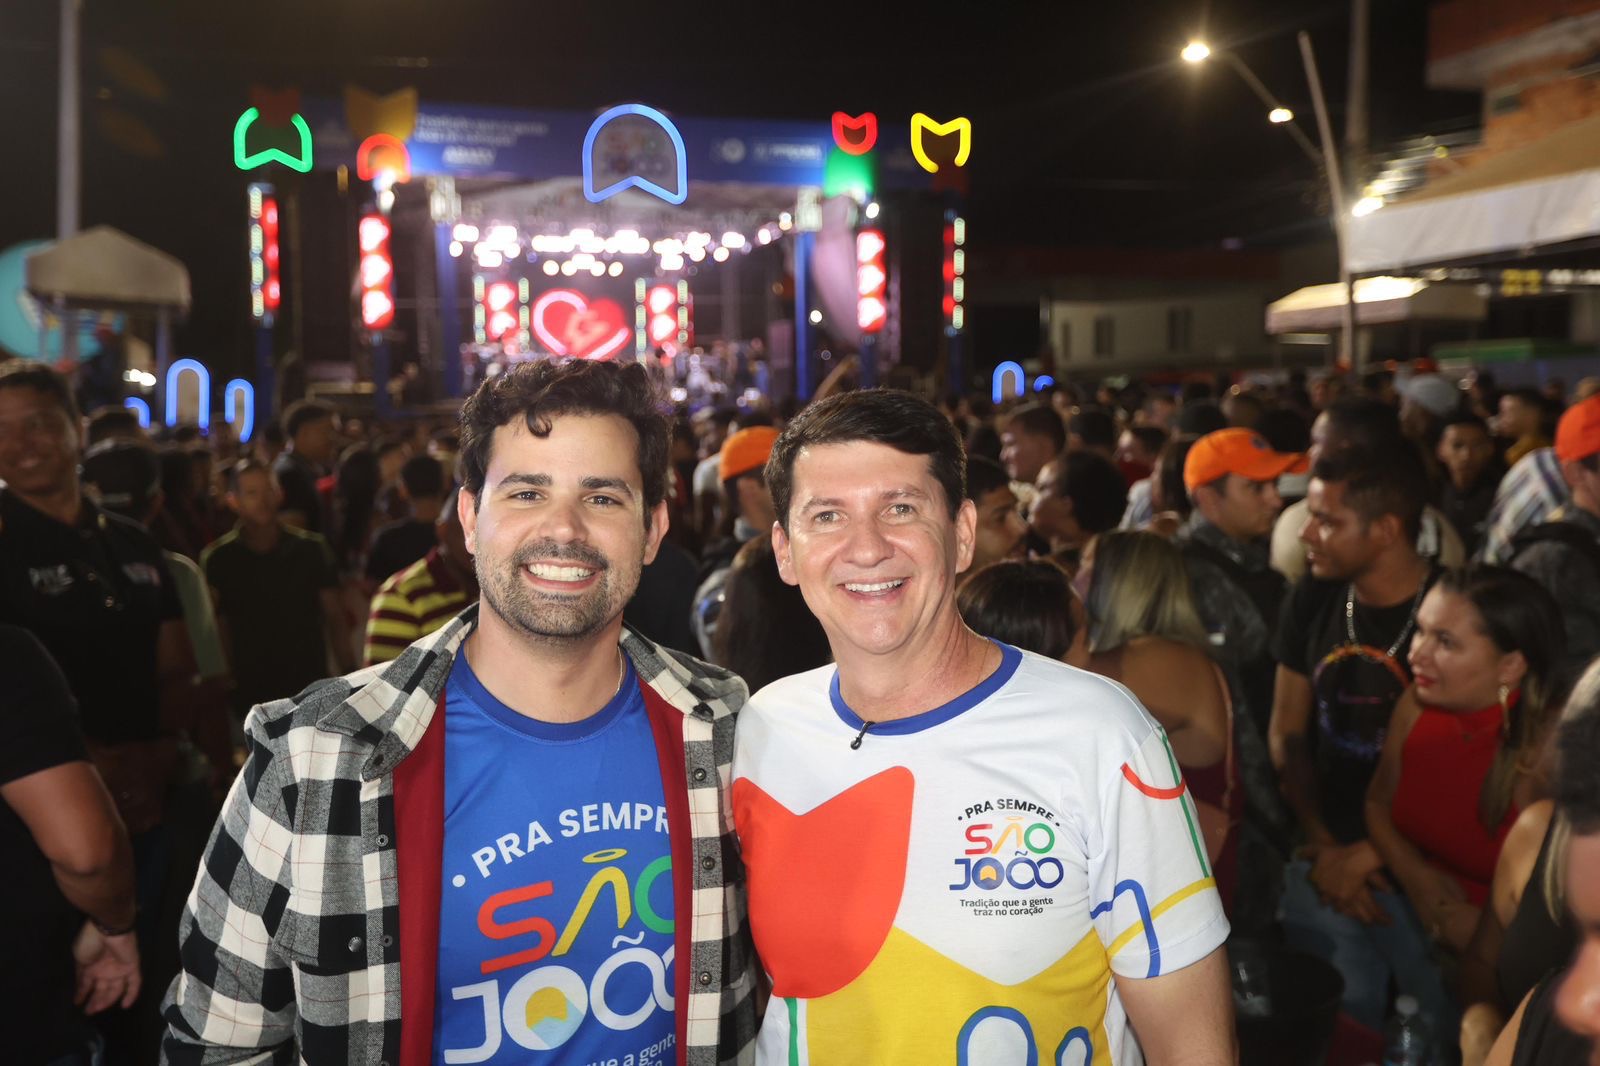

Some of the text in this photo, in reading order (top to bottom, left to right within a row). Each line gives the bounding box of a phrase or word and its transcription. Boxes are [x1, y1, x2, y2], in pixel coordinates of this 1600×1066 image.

[965, 798, 1055, 822] PRA SEMPRE
[471, 802, 670, 879] PRA SEMPR
[965, 816, 1055, 855] SÃO
[949, 850, 1064, 891] JOÃO
[959, 899, 1000, 909] Tradição
[1002, 899, 1020, 908] que
[1029, 897, 1054, 908] gente
[973, 908, 993, 916] traz
[1009, 907, 1044, 917] coração
